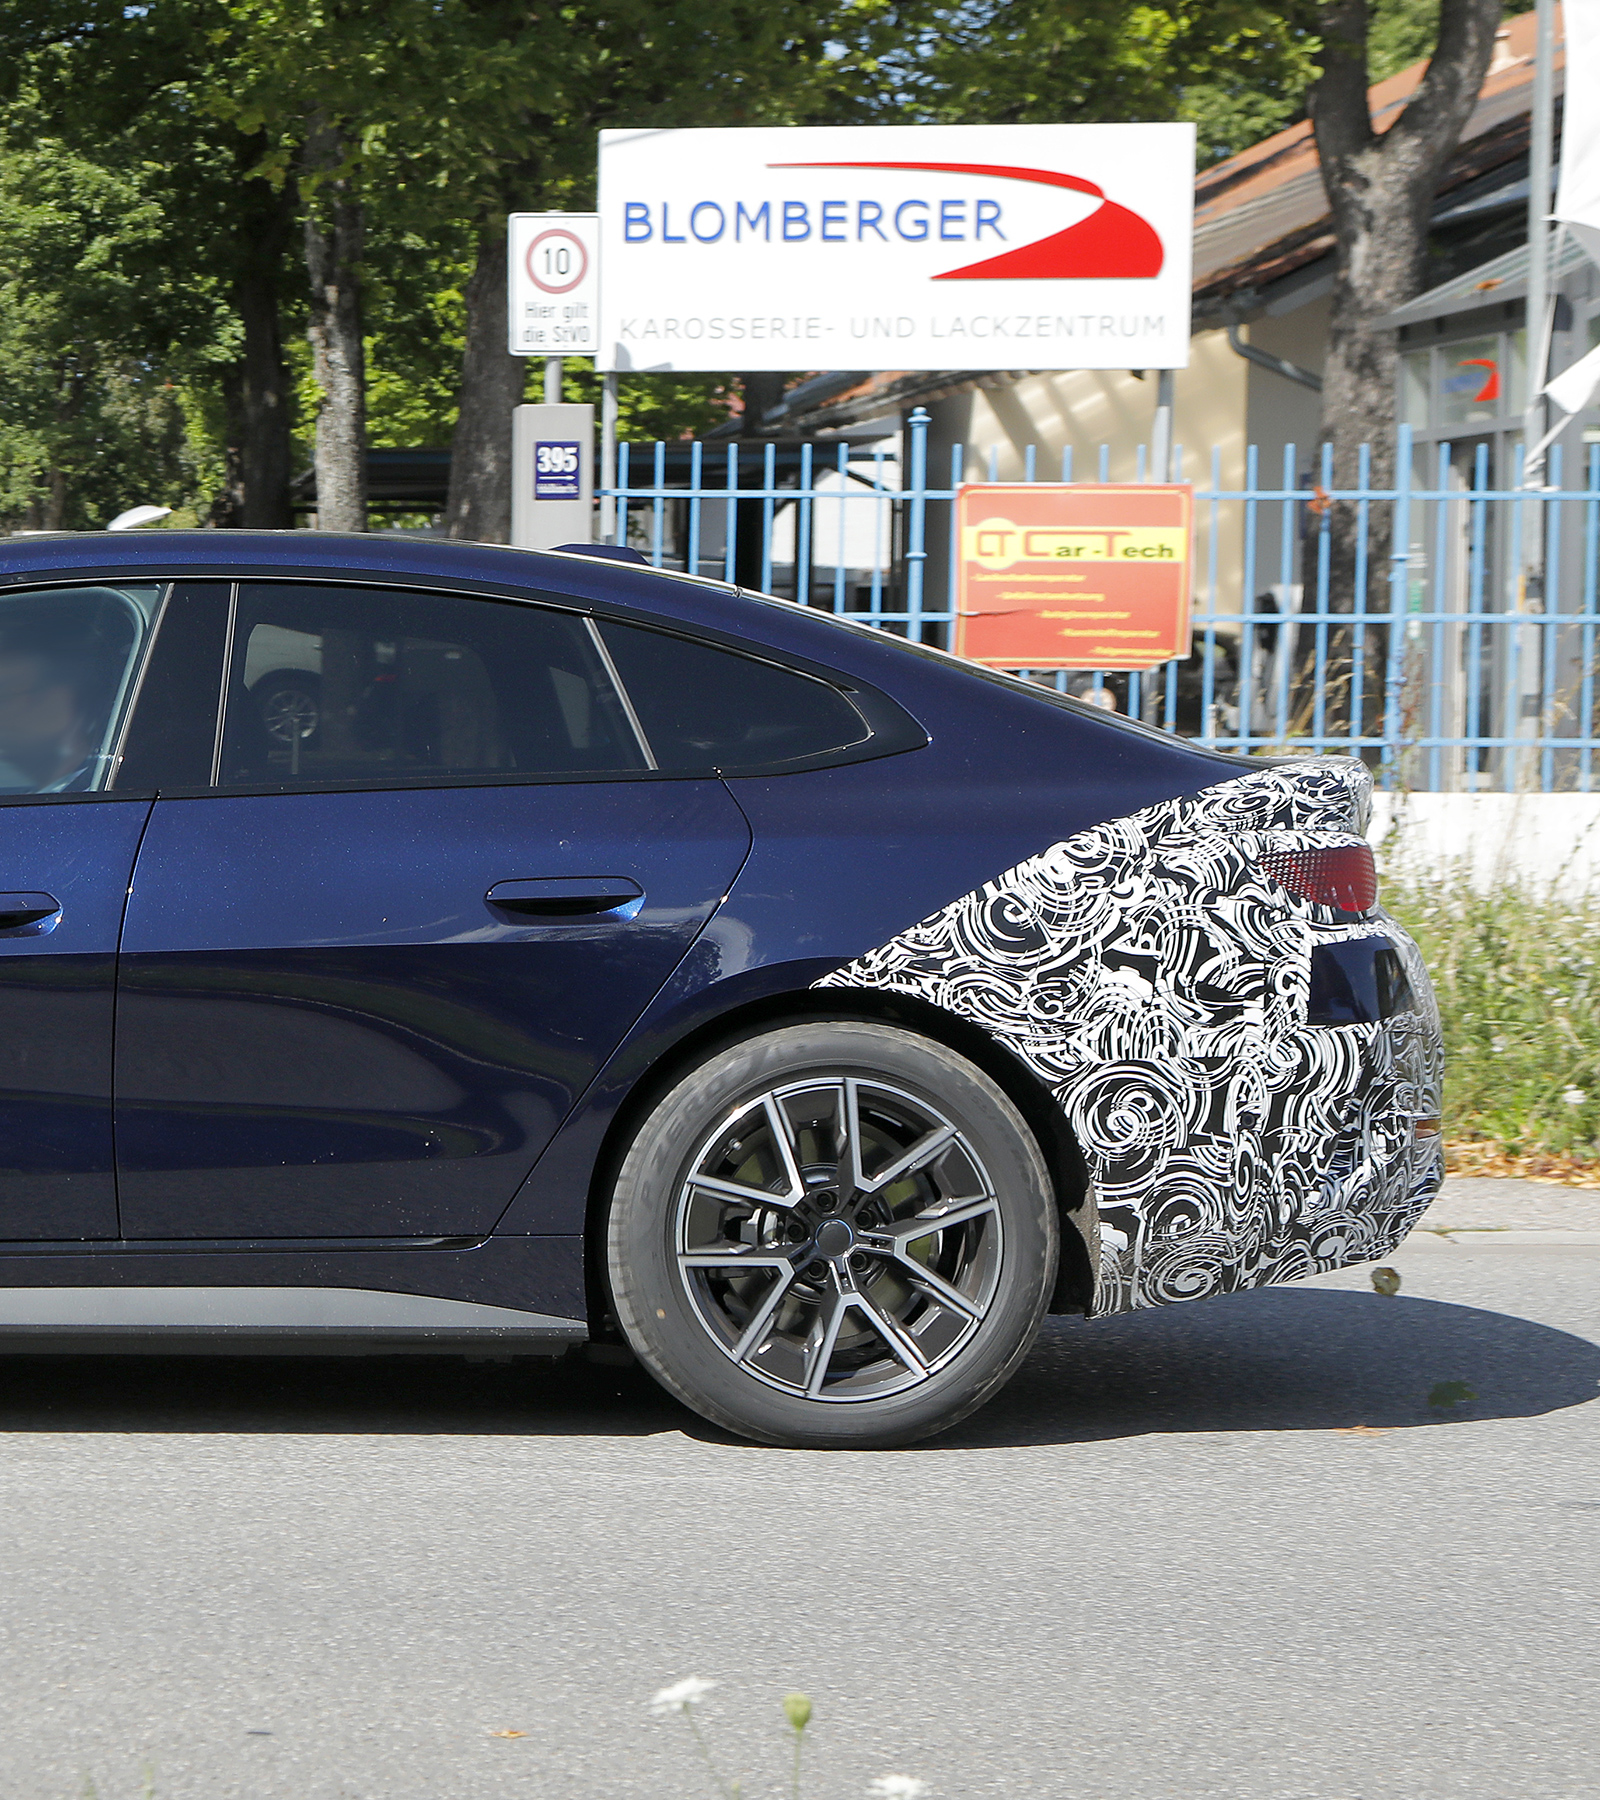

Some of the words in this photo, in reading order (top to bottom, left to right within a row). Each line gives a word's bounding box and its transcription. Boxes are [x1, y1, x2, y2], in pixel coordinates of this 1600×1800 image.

[622, 199, 1007, 244] BLOMBERGER
[543, 247, 570, 276] 10
[525, 302, 556, 318] Hier
[523, 325, 546, 343] die
[619, 317, 835, 340] KAROSSERIE-
[850, 316, 916, 339] UND
[930, 315, 1166, 338] LACKZENTRUM
[537, 446, 578, 473] 395
